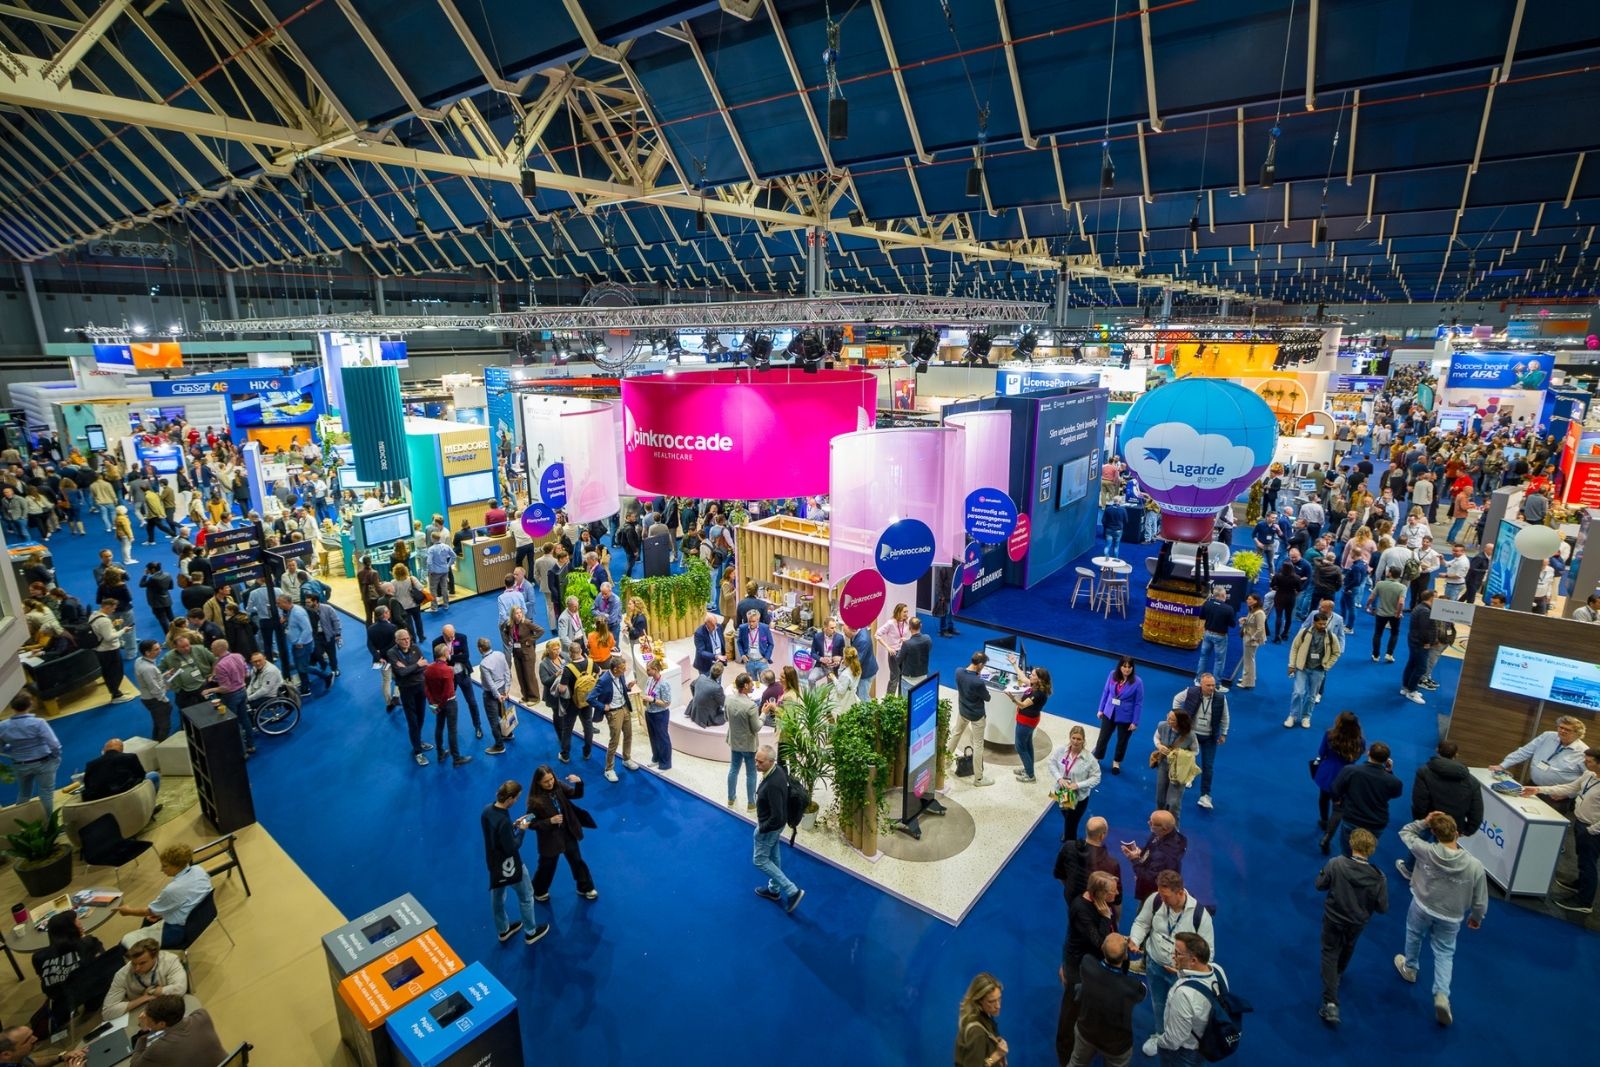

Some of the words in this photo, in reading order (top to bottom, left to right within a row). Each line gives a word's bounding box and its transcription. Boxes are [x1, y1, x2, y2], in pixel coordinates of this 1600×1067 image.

[1454, 362, 1482, 370] Succes
[1484, 363, 1509, 371] begint
[1470, 370, 1501, 378] AFAS
[249, 381, 270, 389] HiX
[1008, 377, 1018, 385] LP
[1023, 376, 1086, 387] LicensePartn
[171, 382, 211, 395] ChipSoft
[634, 427, 733, 451] pinkroccade
[444, 440, 489, 454] MEDICORE
[378, 441, 388, 470] MEDICORE
[654, 451, 694, 461] HEALTHCARE
[1169, 460, 1224, 477] Lagarde
[971, 506, 998, 515] Eenvoudig
[976, 520, 1002, 528] AVG-proof
[890, 546, 931, 558] pinkroccade
[483, 553, 510, 566] Switch
[972, 580, 982, 592] EEN
[982, 568, 1003, 586] DRANKJE
[850, 592, 882, 607] pinkroccade
[1150, 601, 1194, 614] adballon.nl
[411, 1023, 425, 1039] Paper
[420, 1016, 435, 1033] Papier
